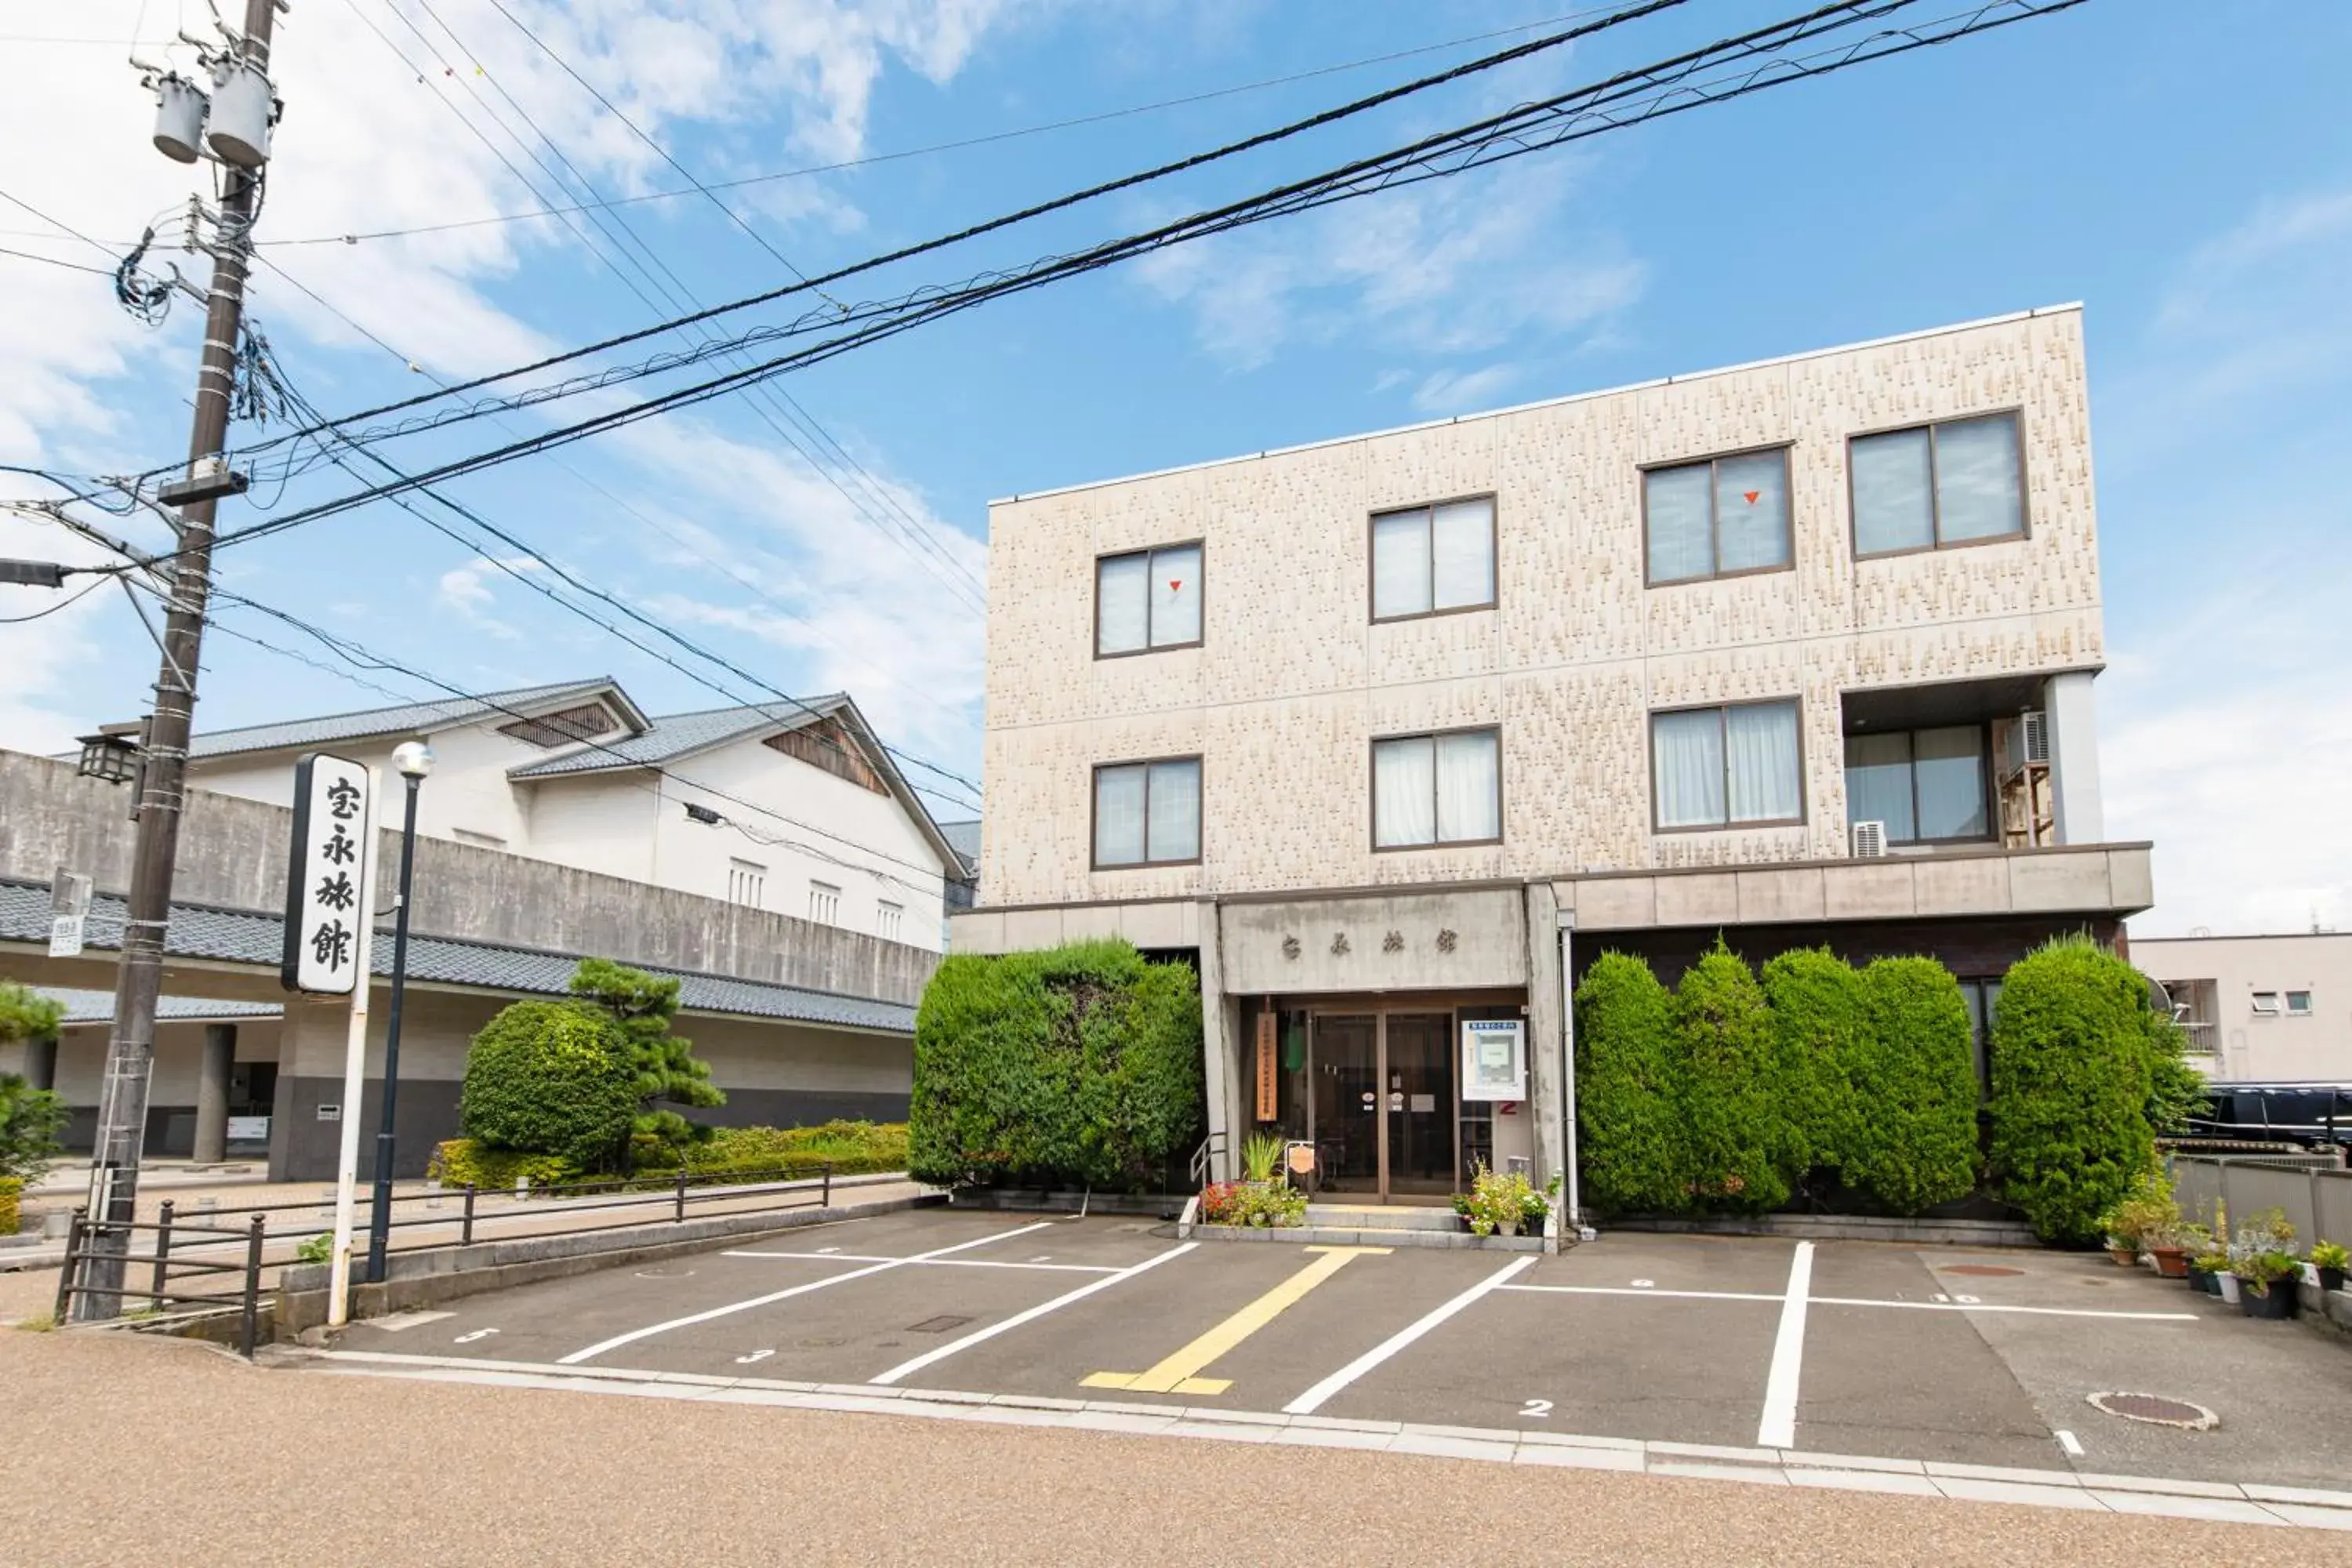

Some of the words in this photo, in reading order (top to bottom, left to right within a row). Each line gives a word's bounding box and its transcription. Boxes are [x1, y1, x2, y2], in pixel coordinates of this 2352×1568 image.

[311, 777, 361, 974] 宝永旅館
[1518, 1399, 1554, 1417] 2
